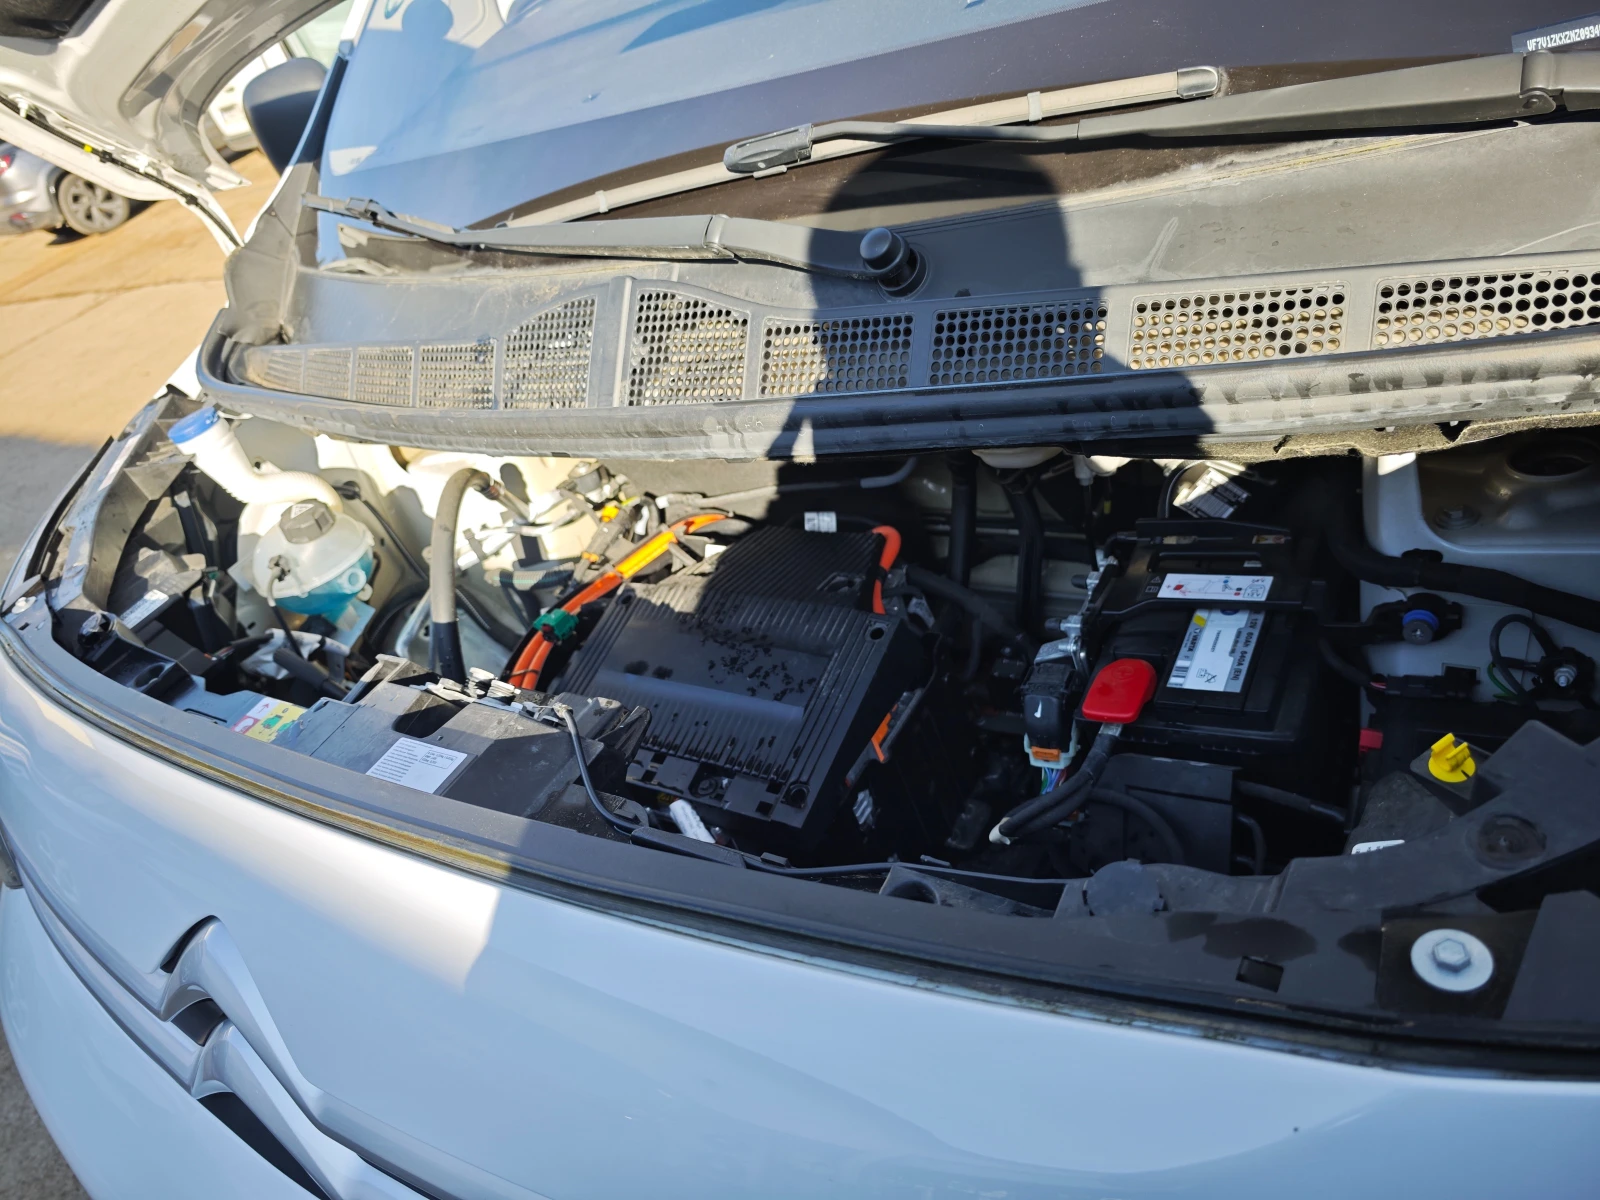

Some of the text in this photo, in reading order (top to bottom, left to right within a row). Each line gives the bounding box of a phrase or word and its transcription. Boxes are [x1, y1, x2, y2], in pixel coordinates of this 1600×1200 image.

[1526, 24, 1600, 52] VF7V1ZKXZNZ0934
[1249, 618, 1258, 629] 12V
[1187, 634, 1199, 651] VARTA
